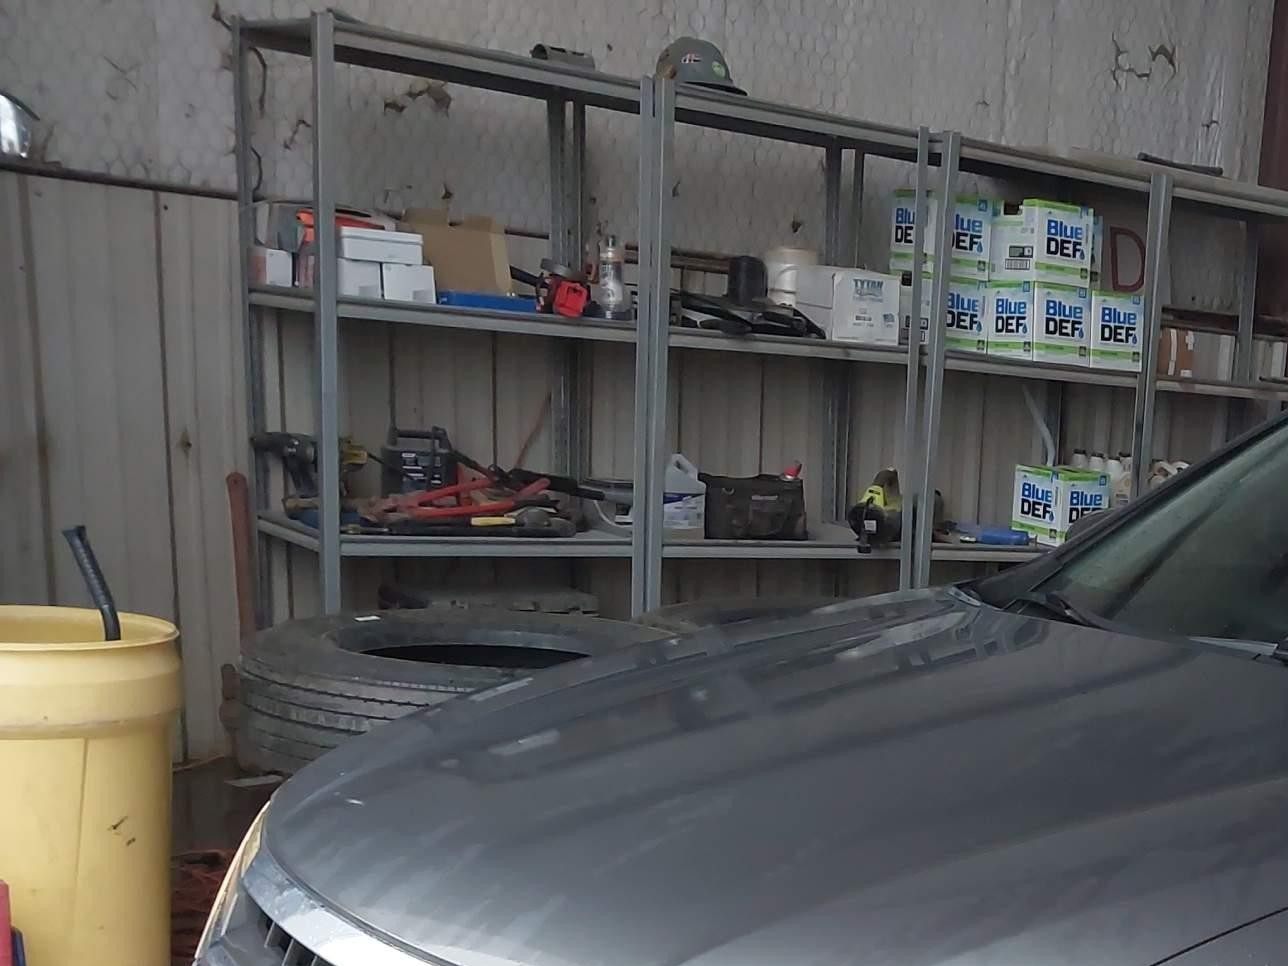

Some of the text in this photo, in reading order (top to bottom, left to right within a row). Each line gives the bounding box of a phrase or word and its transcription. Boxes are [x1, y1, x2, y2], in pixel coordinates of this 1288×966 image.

[896, 208, 915, 224] Blu
[955, 213, 983, 233] lue
[895, 225, 914, 243] DE
[1047, 219, 1083, 240] Blue
[952, 232, 982, 251] EF
[1046, 237, 1082, 259] DEF
[995, 298, 1027, 314] Blue
[1046, 299, 1083, 319] Blue
[946, 310, 978, 330] DEF
[995, 316, 1027, 333] DEF
[1102, 307, 1137, 325] Blue
[1045, 317, 1082, 337] DEF
[1100, 324, 1136, 343] DEF
[1021, 482, 1052, 501] Blue
[1070, 491, 1103, 506] Blue
[1020, 498, 1052, 520] DEF
